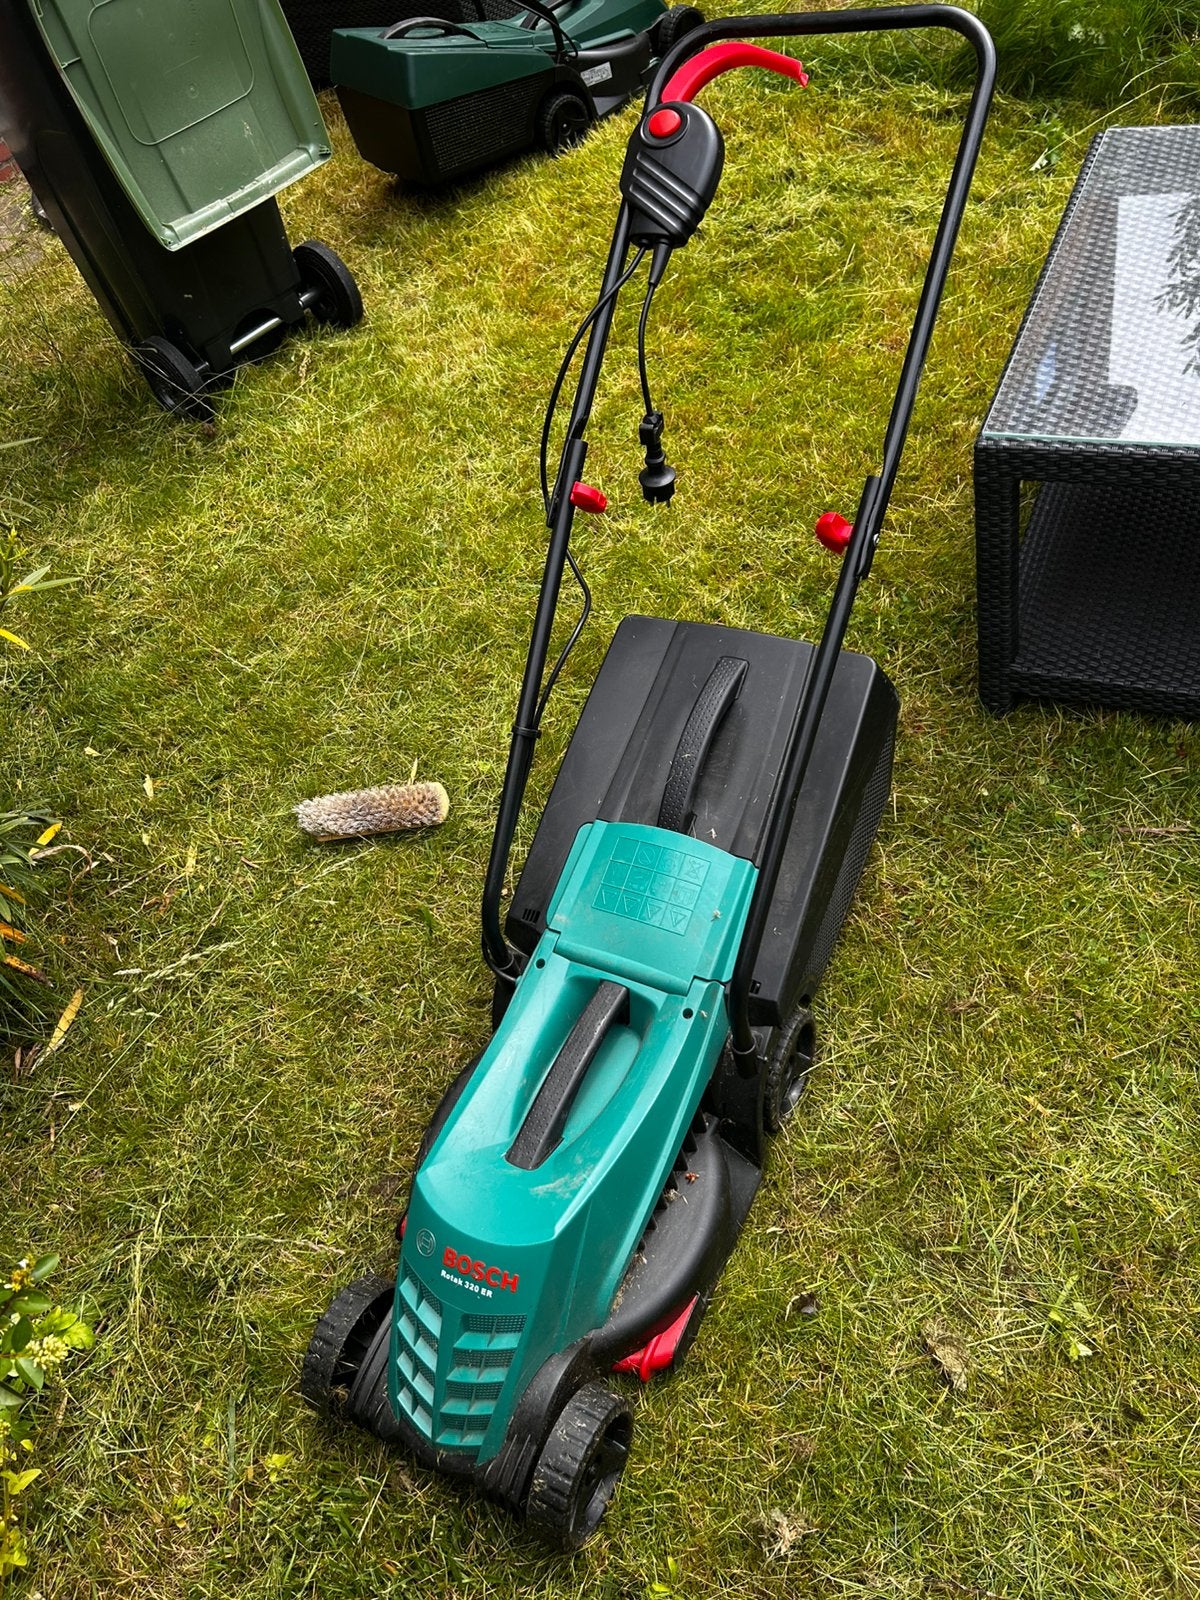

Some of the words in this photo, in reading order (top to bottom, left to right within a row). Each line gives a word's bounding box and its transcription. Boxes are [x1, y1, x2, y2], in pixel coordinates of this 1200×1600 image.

[440, 1269, 463, 1286] Rotak
[464, 1280, 480, 1293] 320
[480, 1287, 493, 1298] ER
[442, 1246, 519, 1293] BOSCH
